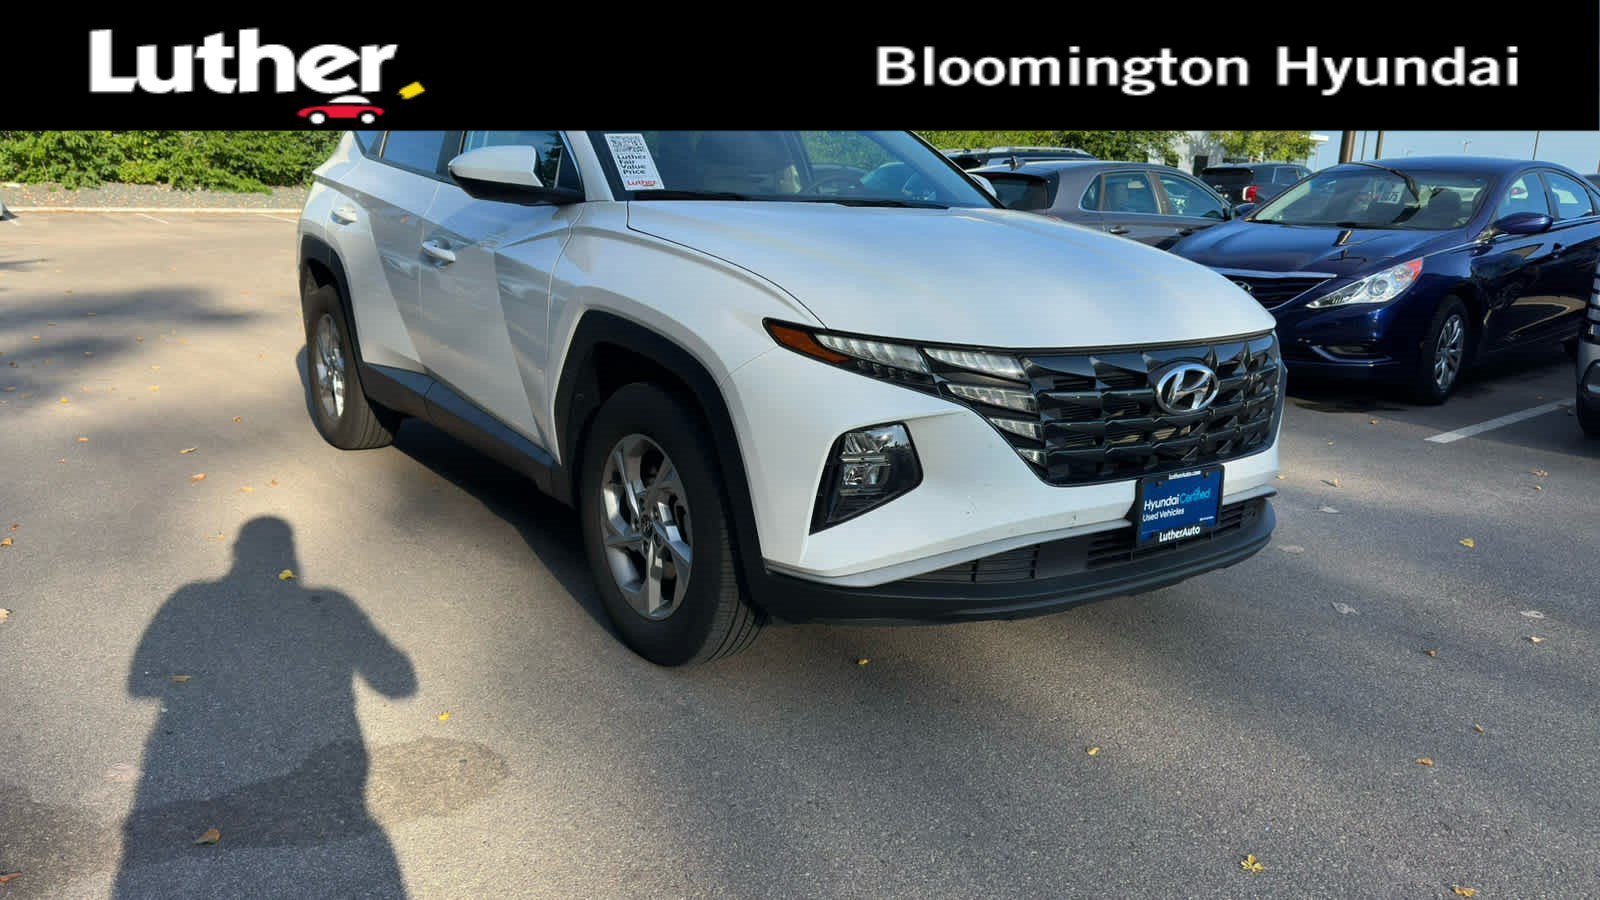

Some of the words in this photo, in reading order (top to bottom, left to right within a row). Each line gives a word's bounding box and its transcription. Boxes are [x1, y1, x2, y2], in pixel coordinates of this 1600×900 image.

[1143, 494, 1180, 511] Hyundai
[1180, 487, 1211, 504] Certified
[1142, 512, 1159, 522] Used
[1160, 508, 1184, 518] Vehicles
[1159, 526, 1201, 543] LutherAuto
